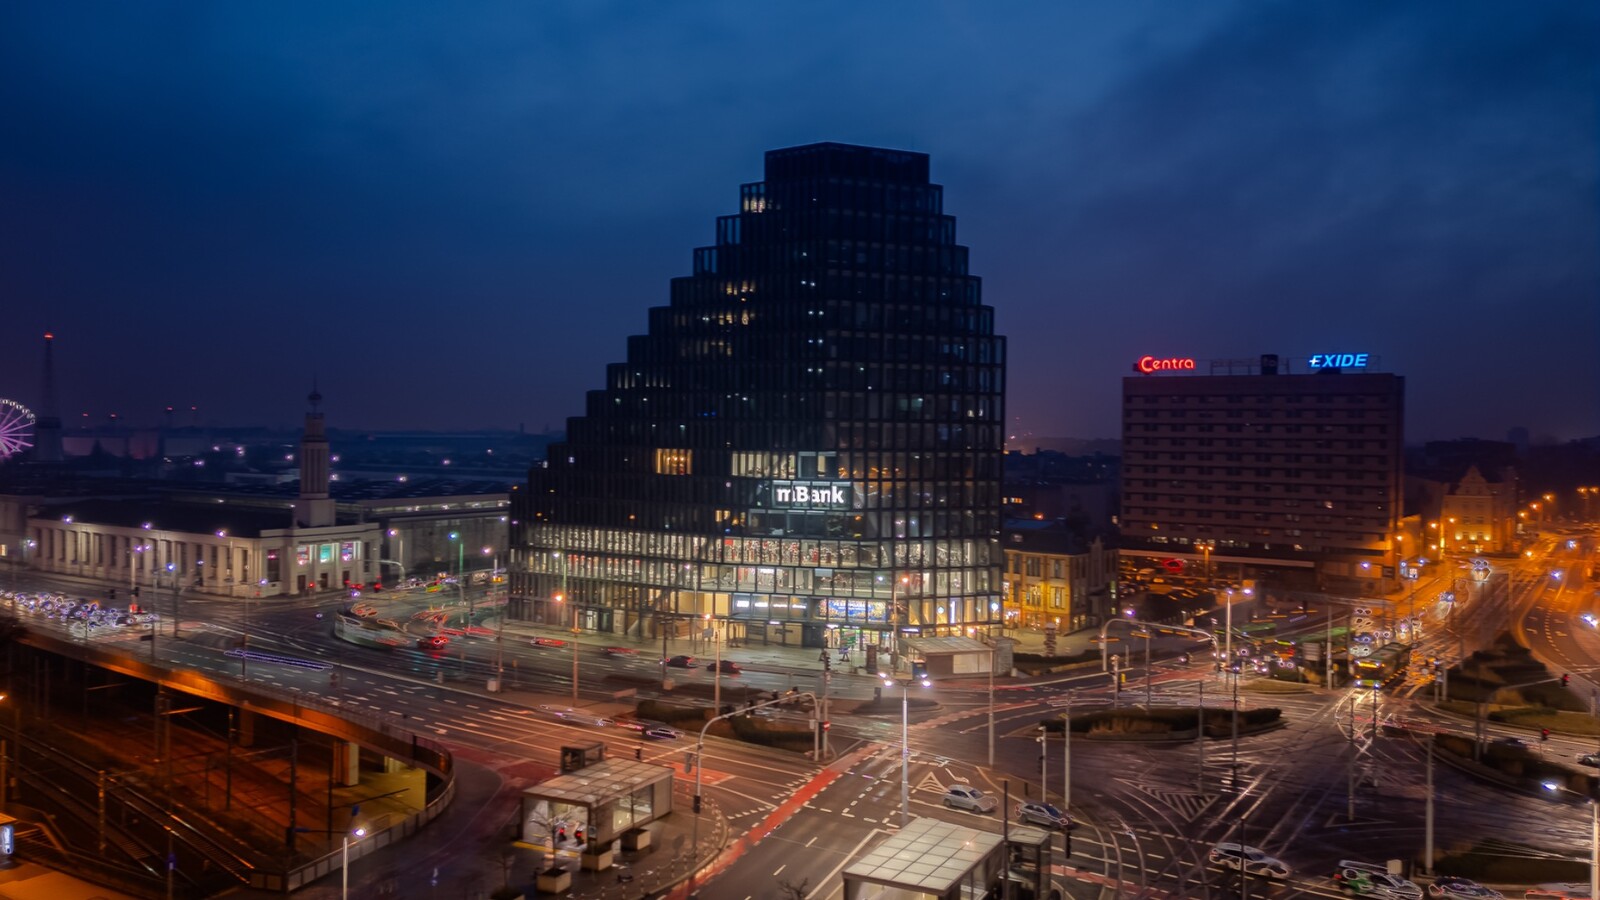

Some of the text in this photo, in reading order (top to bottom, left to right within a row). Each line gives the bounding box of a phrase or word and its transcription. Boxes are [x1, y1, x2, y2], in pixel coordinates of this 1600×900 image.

[1140, 355, 1195, 372] Centra
[1309, 353, 1368, 368] EXIDE
[776, 485, 844, 503] mBank
